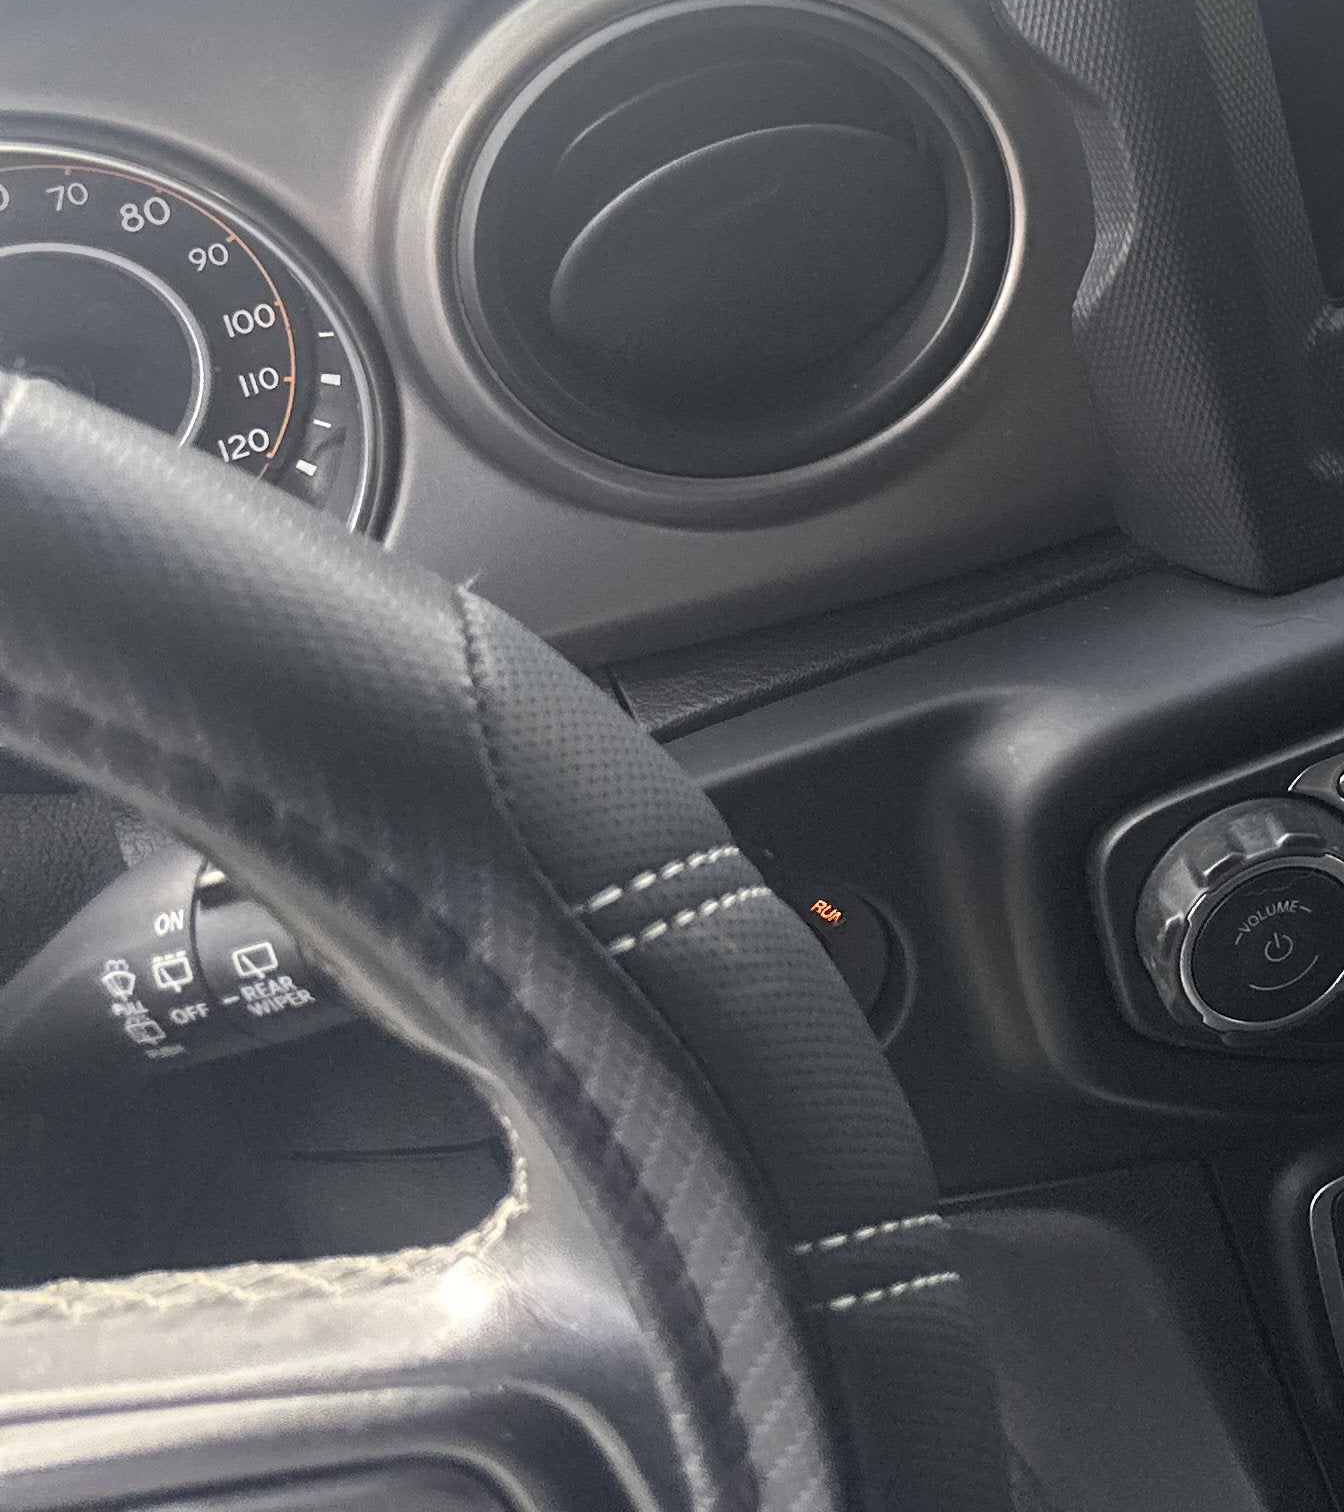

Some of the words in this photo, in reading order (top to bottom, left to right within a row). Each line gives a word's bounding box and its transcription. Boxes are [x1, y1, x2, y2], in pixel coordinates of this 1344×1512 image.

[47, 182, 88, 211] 70
[119, 196, 172, 232] 80
[188, 242, 230, 271] 90
[223, 303, 276, 338] 100
[238, 366, 280, 398] 110
[217, 427, 269, 463] 120
[154, 909, 184, 936] ON
[810, 898, 843, 926] RUN
[1239, 900, 1298, 935] VOLUME
[240, 975, 296, 1002] REAR
[168, 1002, 210, 1026] OFF
[246, 989, 317, 1018] WIPER
